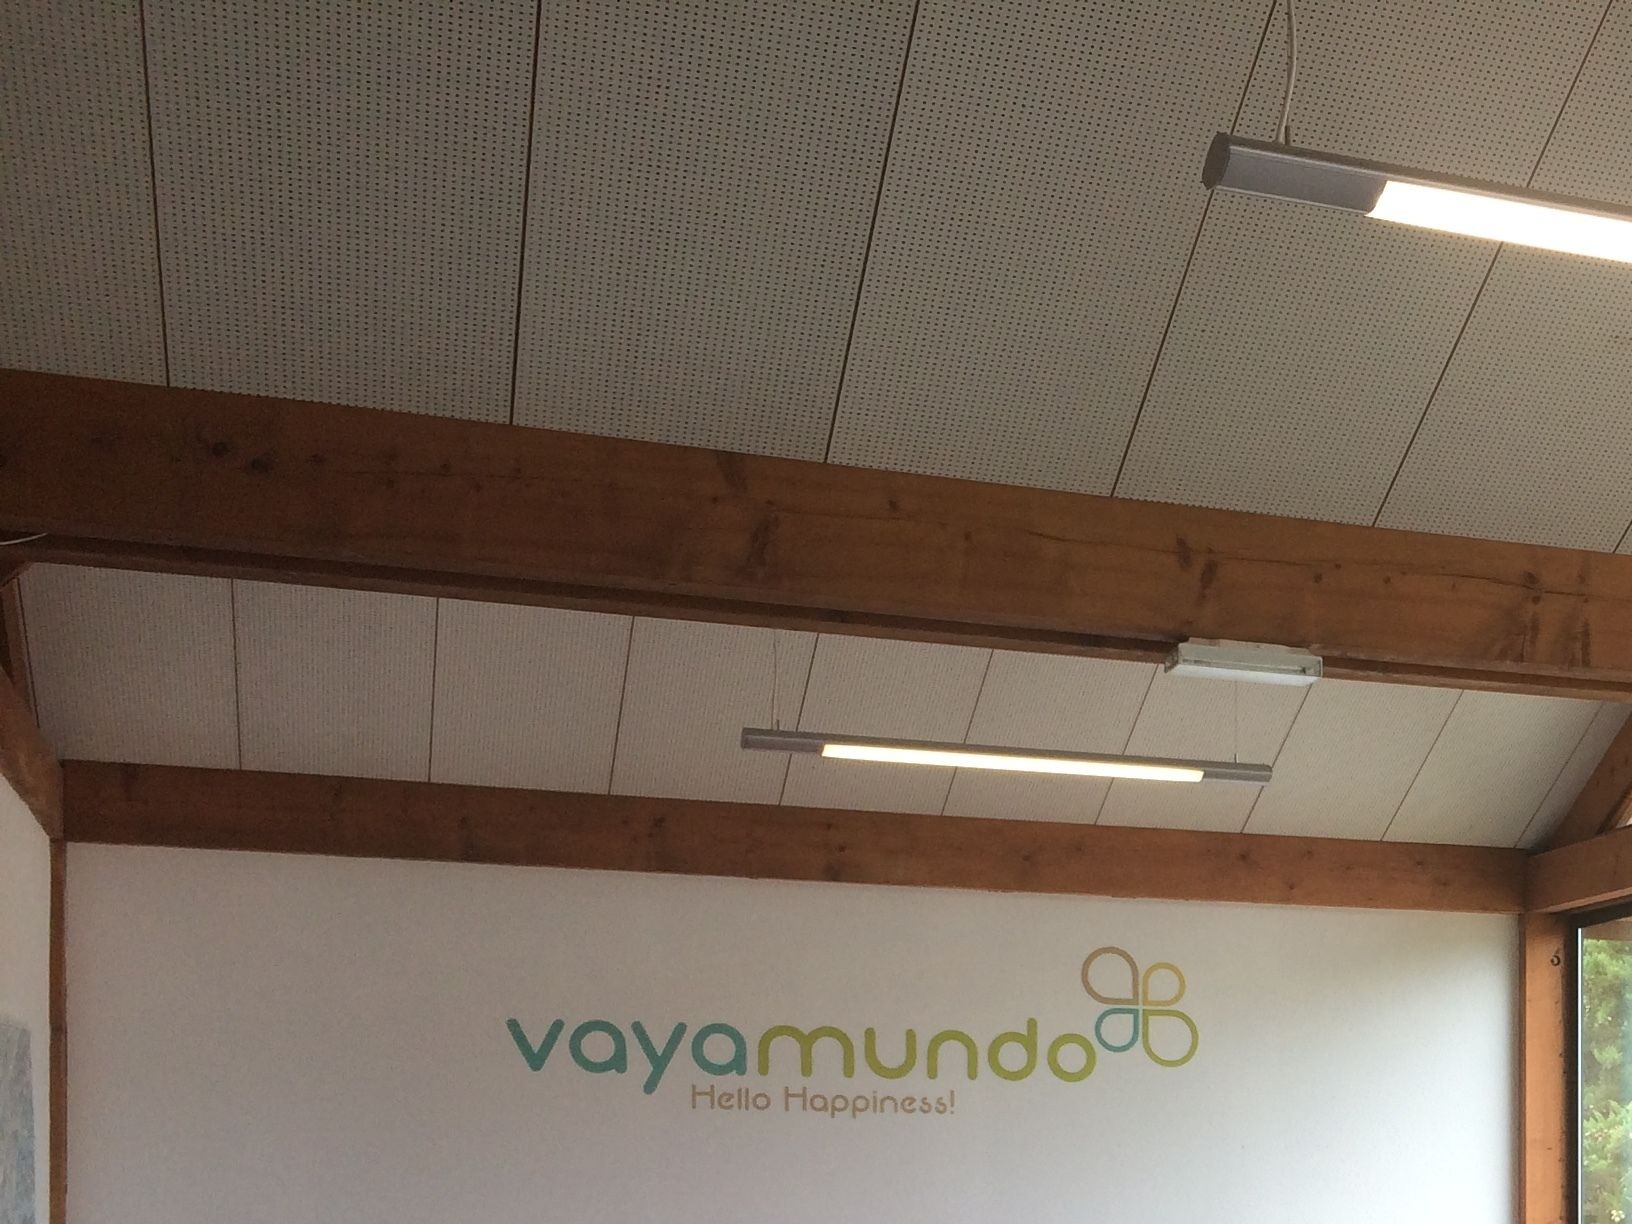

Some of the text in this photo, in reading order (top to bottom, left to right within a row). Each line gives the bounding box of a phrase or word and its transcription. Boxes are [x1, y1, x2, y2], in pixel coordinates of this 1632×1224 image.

[506, 1016, 1097, 1095] vayamundo
[690, 1083, 956, 1119] Hello Happiness!
